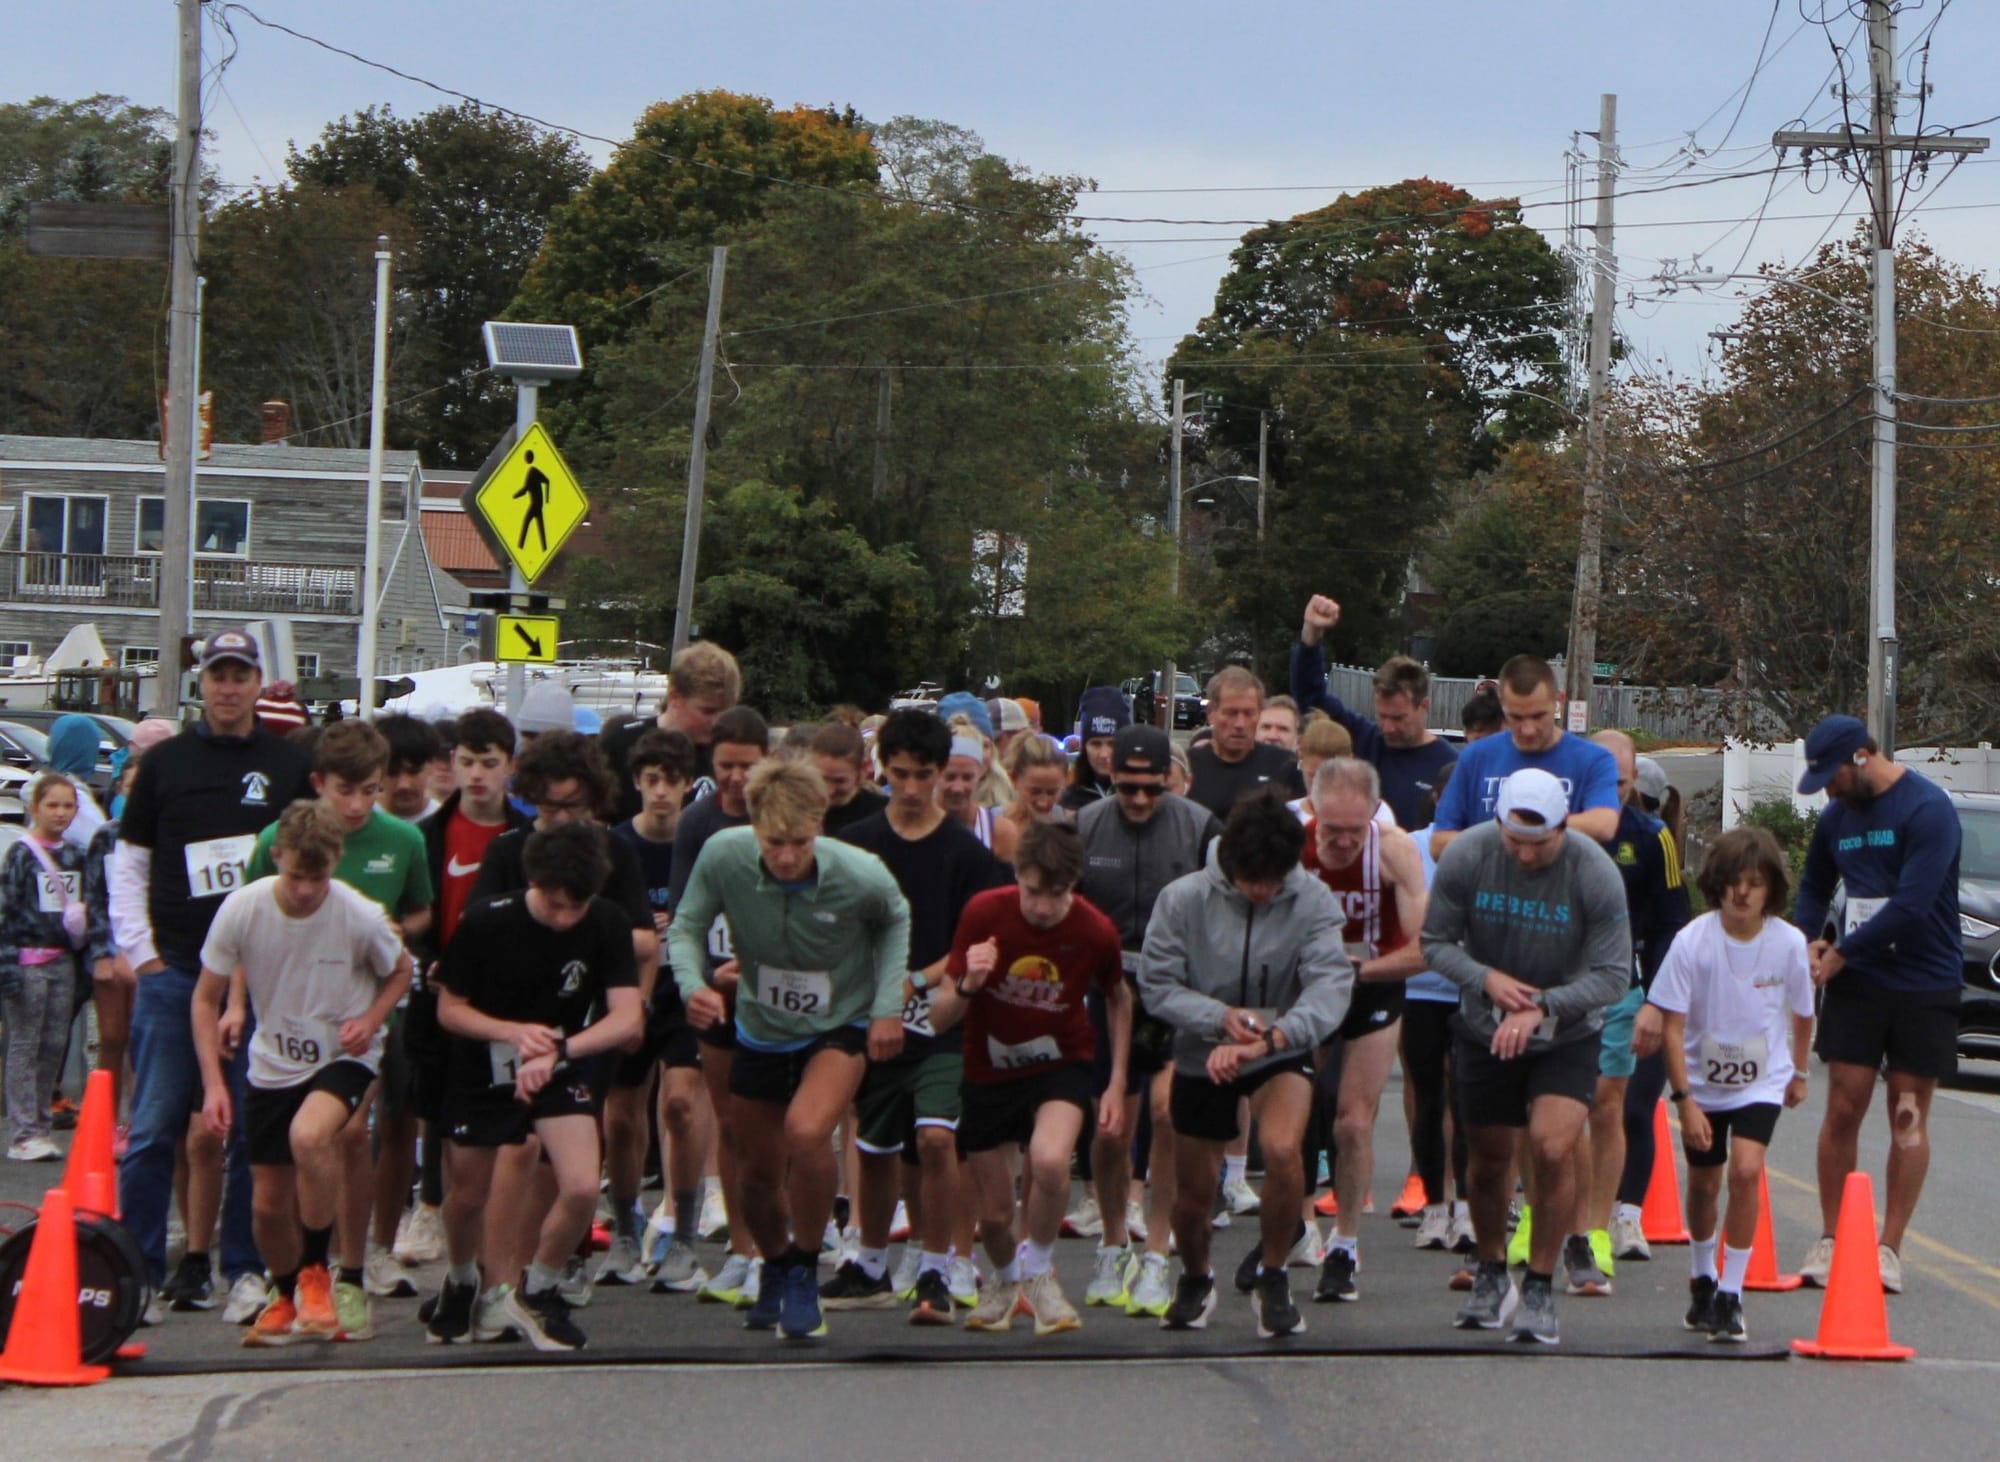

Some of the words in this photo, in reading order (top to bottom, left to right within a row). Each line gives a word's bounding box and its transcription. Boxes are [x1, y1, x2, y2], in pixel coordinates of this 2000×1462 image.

[45, 874, 75, 895] 22
[1476, 891, 1570, 924] REBELS
[768, 985, 819, 1014] 162
[274, 1032, 320, 1065] 169
[1707, 1059, 1758, 1085] 229
